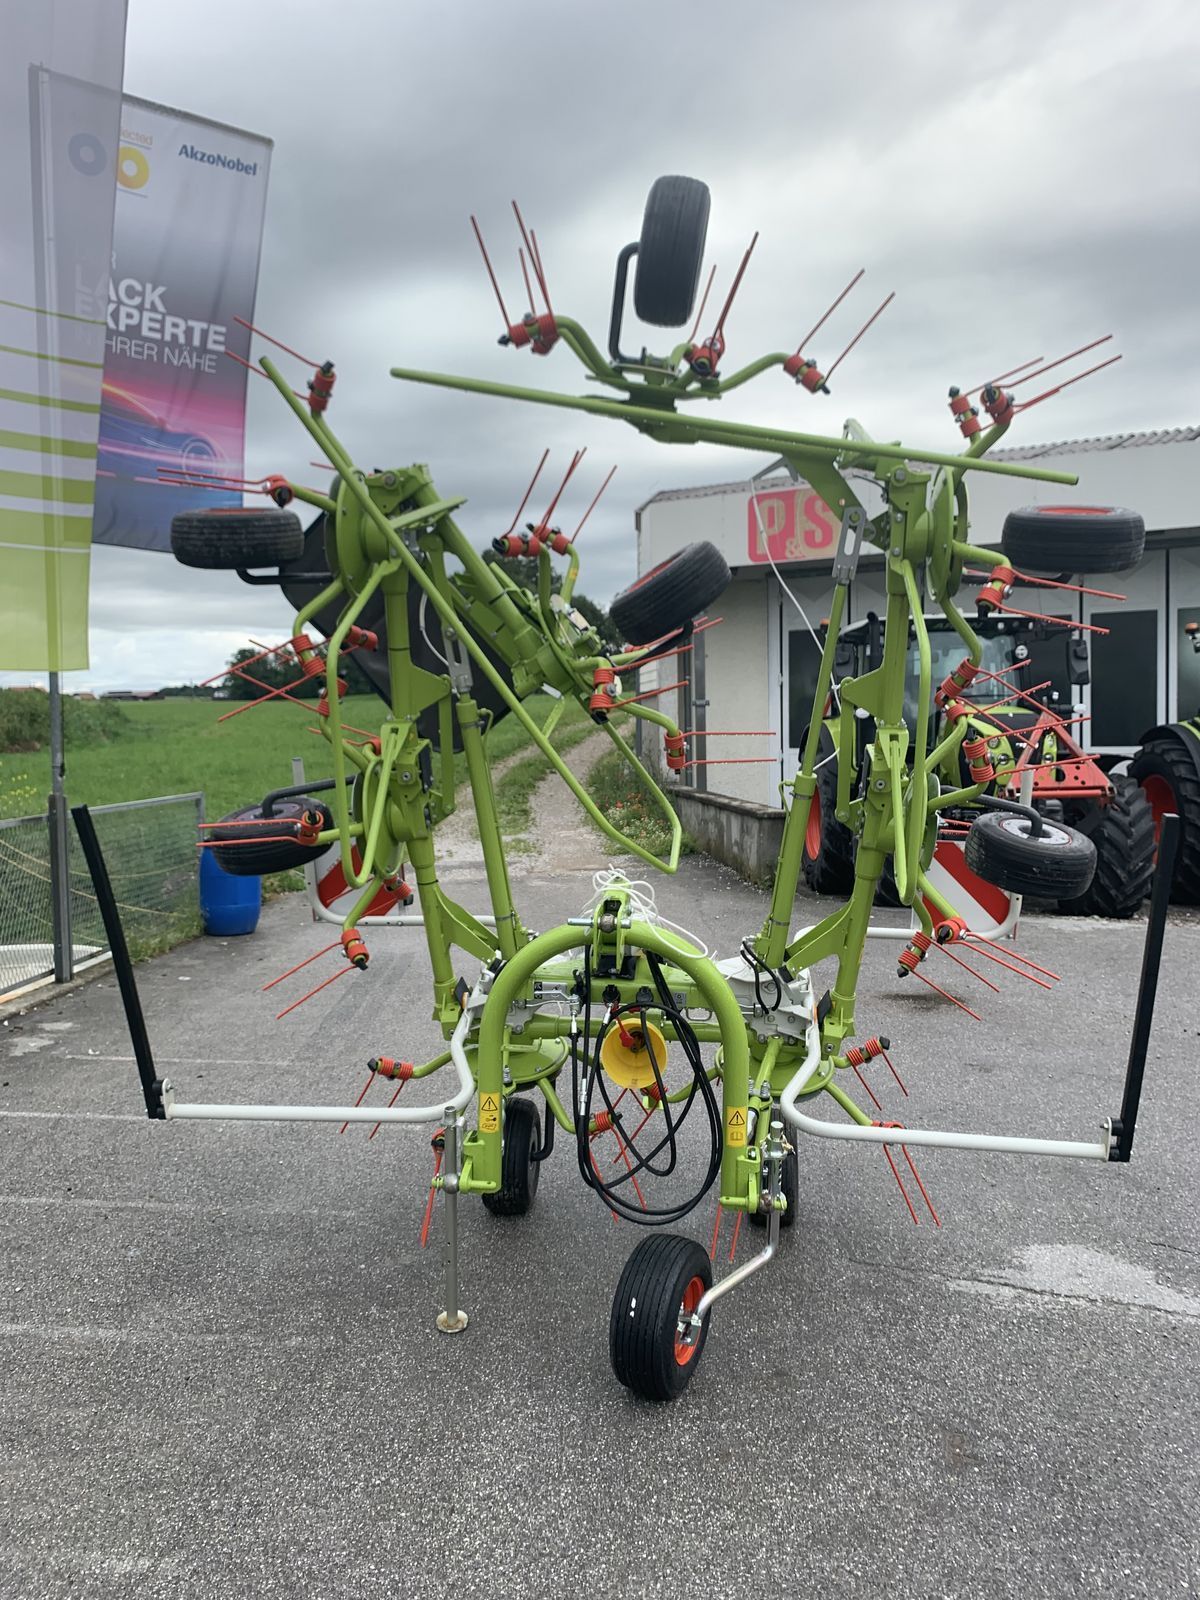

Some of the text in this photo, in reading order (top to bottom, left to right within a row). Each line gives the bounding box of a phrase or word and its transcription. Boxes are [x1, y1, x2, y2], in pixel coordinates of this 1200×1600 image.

[120, 128, 153, 146] ected
[178, 144, 257, 176] AkzoNobel
[104, 335, 158, 362] HRER
[163, 345, 218, 374] NÄHE
